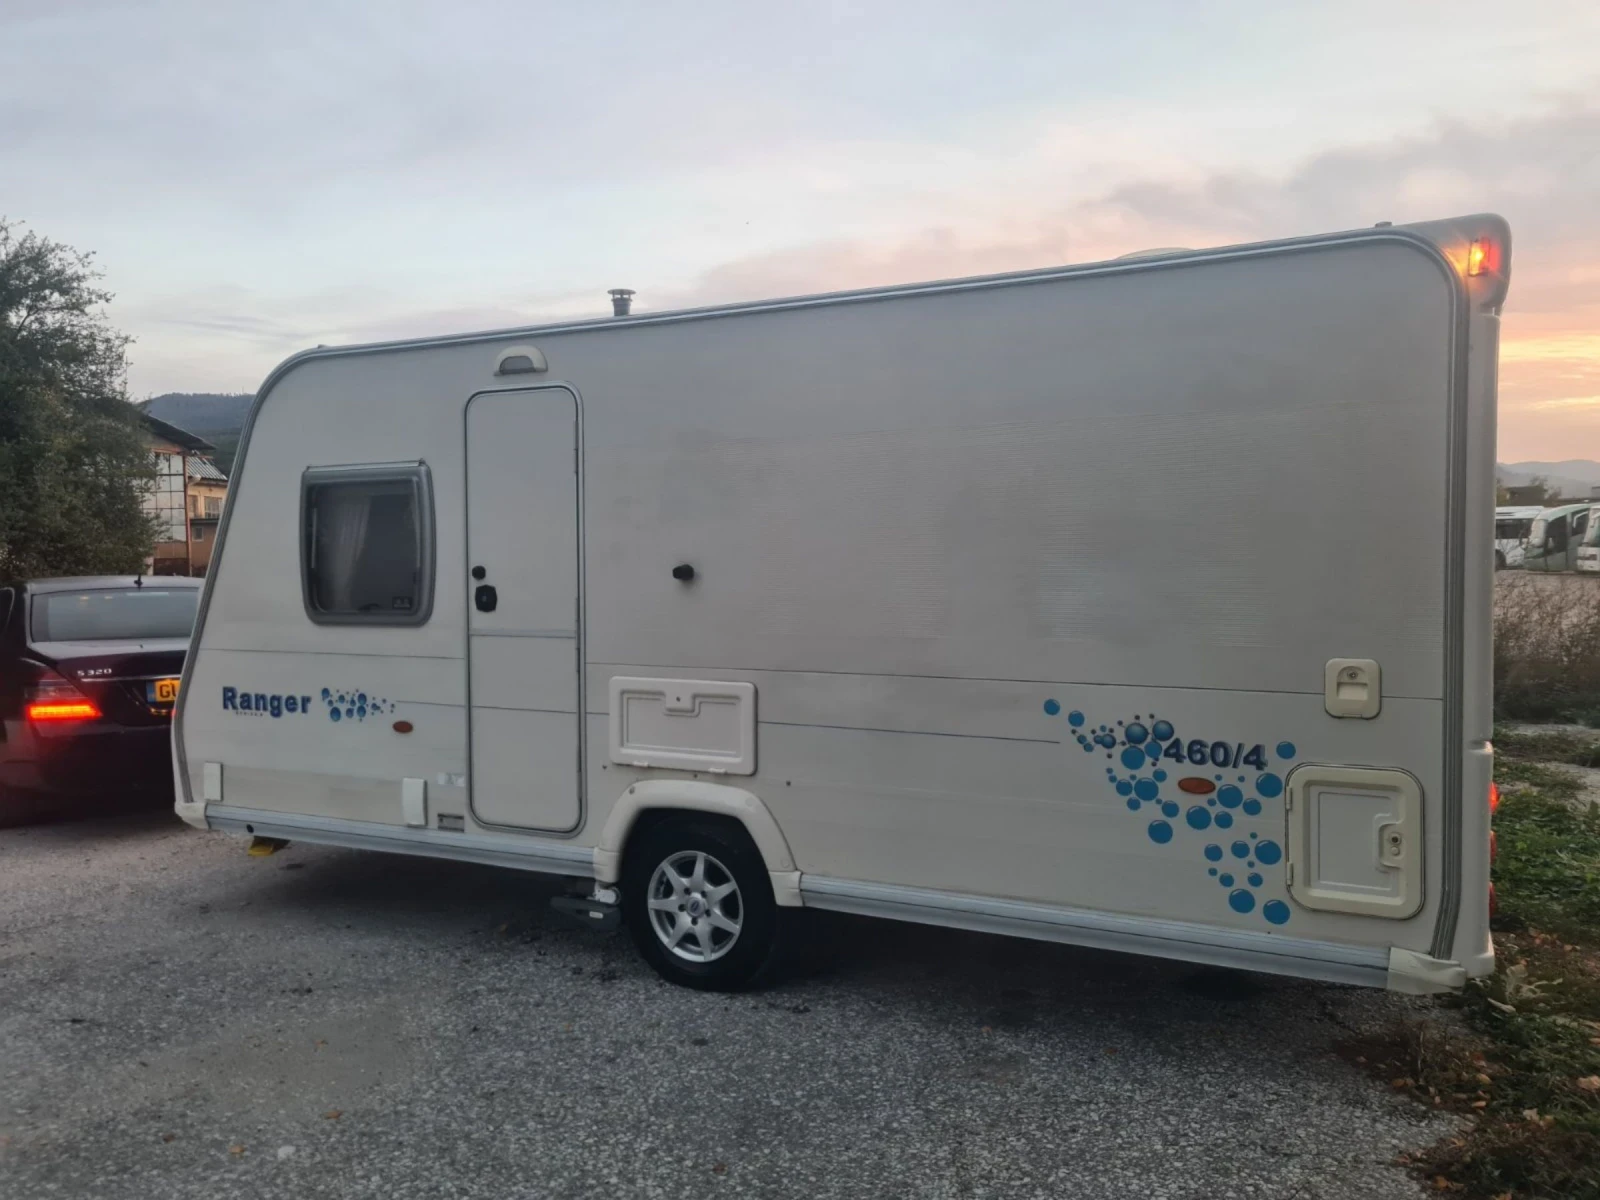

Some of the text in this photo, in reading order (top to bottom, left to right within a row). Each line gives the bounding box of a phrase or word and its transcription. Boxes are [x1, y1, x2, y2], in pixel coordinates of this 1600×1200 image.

[87, 668, 112, 676] 320
[222, 686, 312, 718] Ranger
[1163, 737, 1268, 771] 460/4
